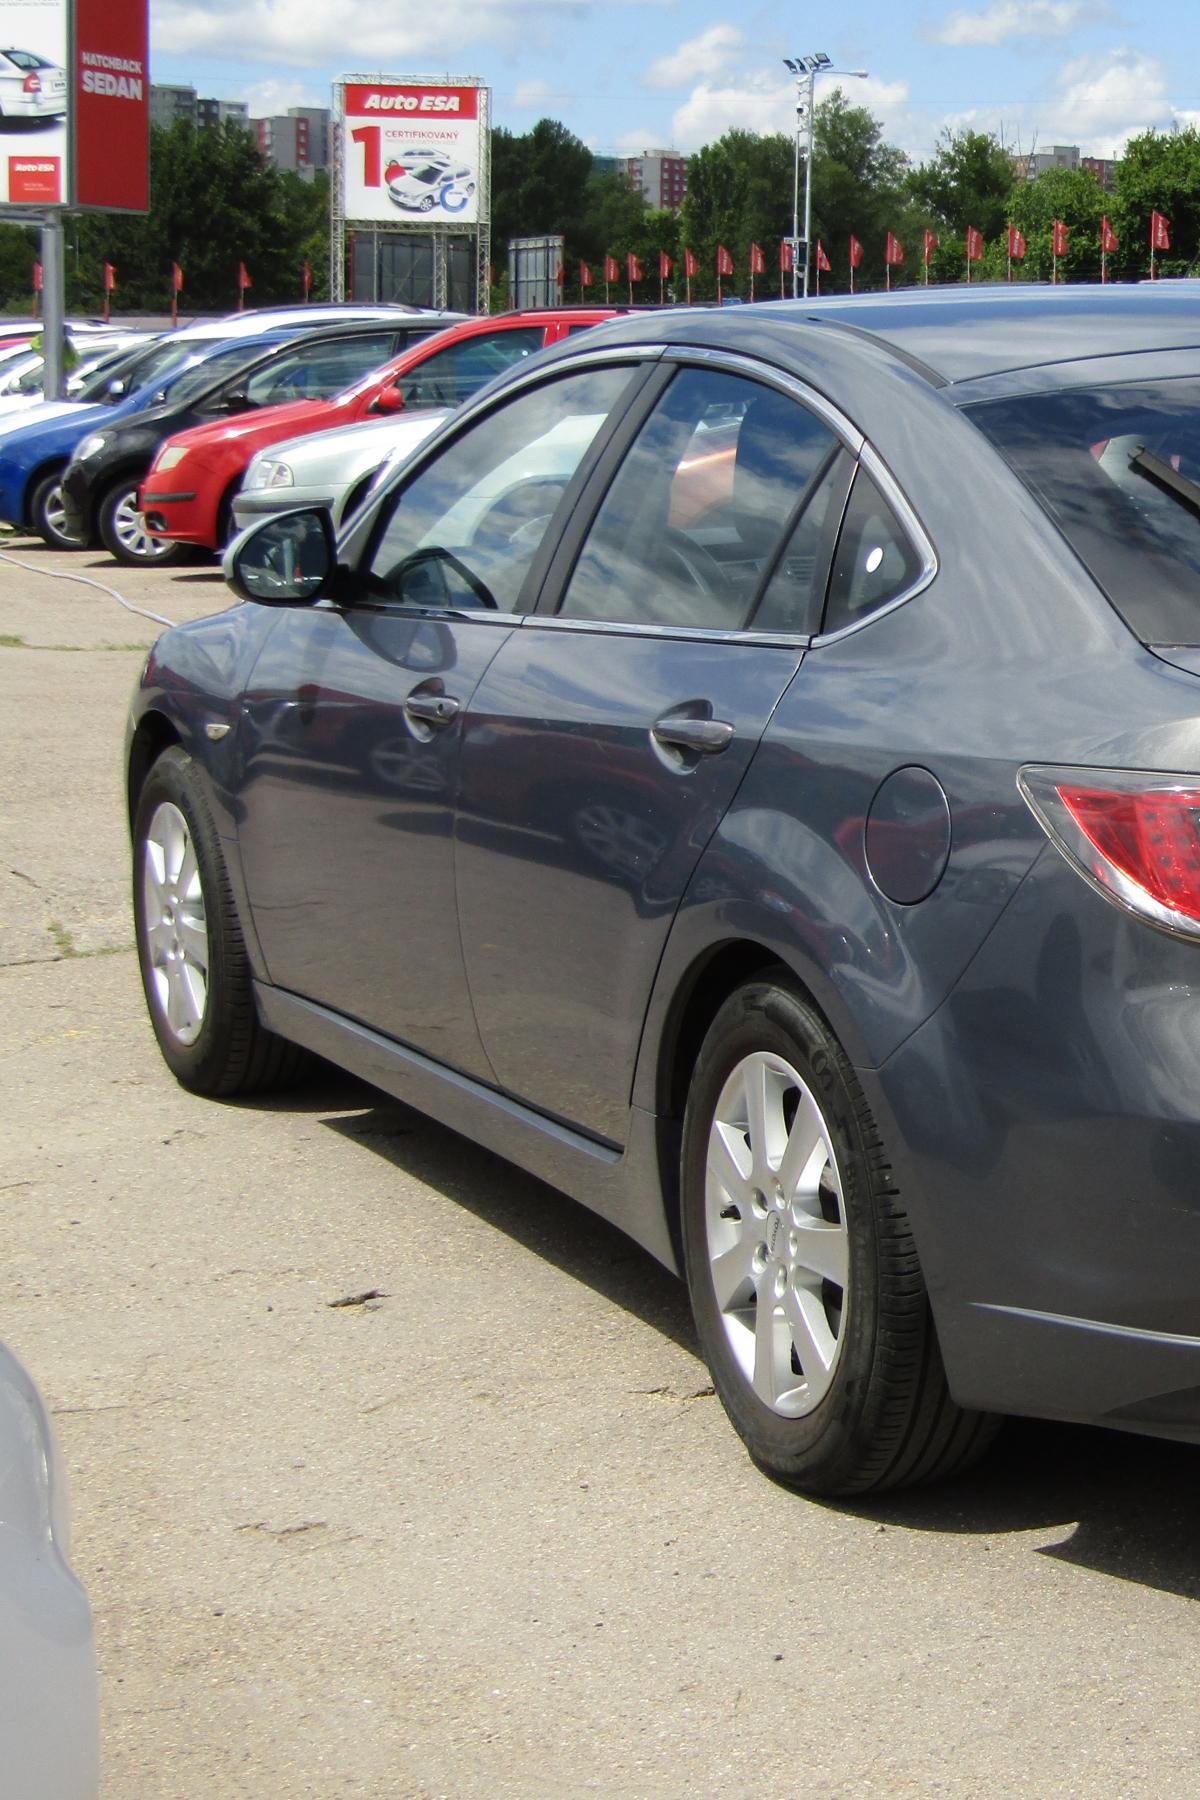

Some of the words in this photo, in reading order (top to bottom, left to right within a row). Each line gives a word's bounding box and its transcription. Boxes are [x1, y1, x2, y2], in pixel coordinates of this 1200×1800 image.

[82, 51, 142, 74] HATCHBACK
[82, 70, 142, 101] SEDAN
[364, 94, 418, 110] Auto
[420, 96, 460, 111] ESA
[385, 129, 460, 140] CERTIFIKOVANÝ
